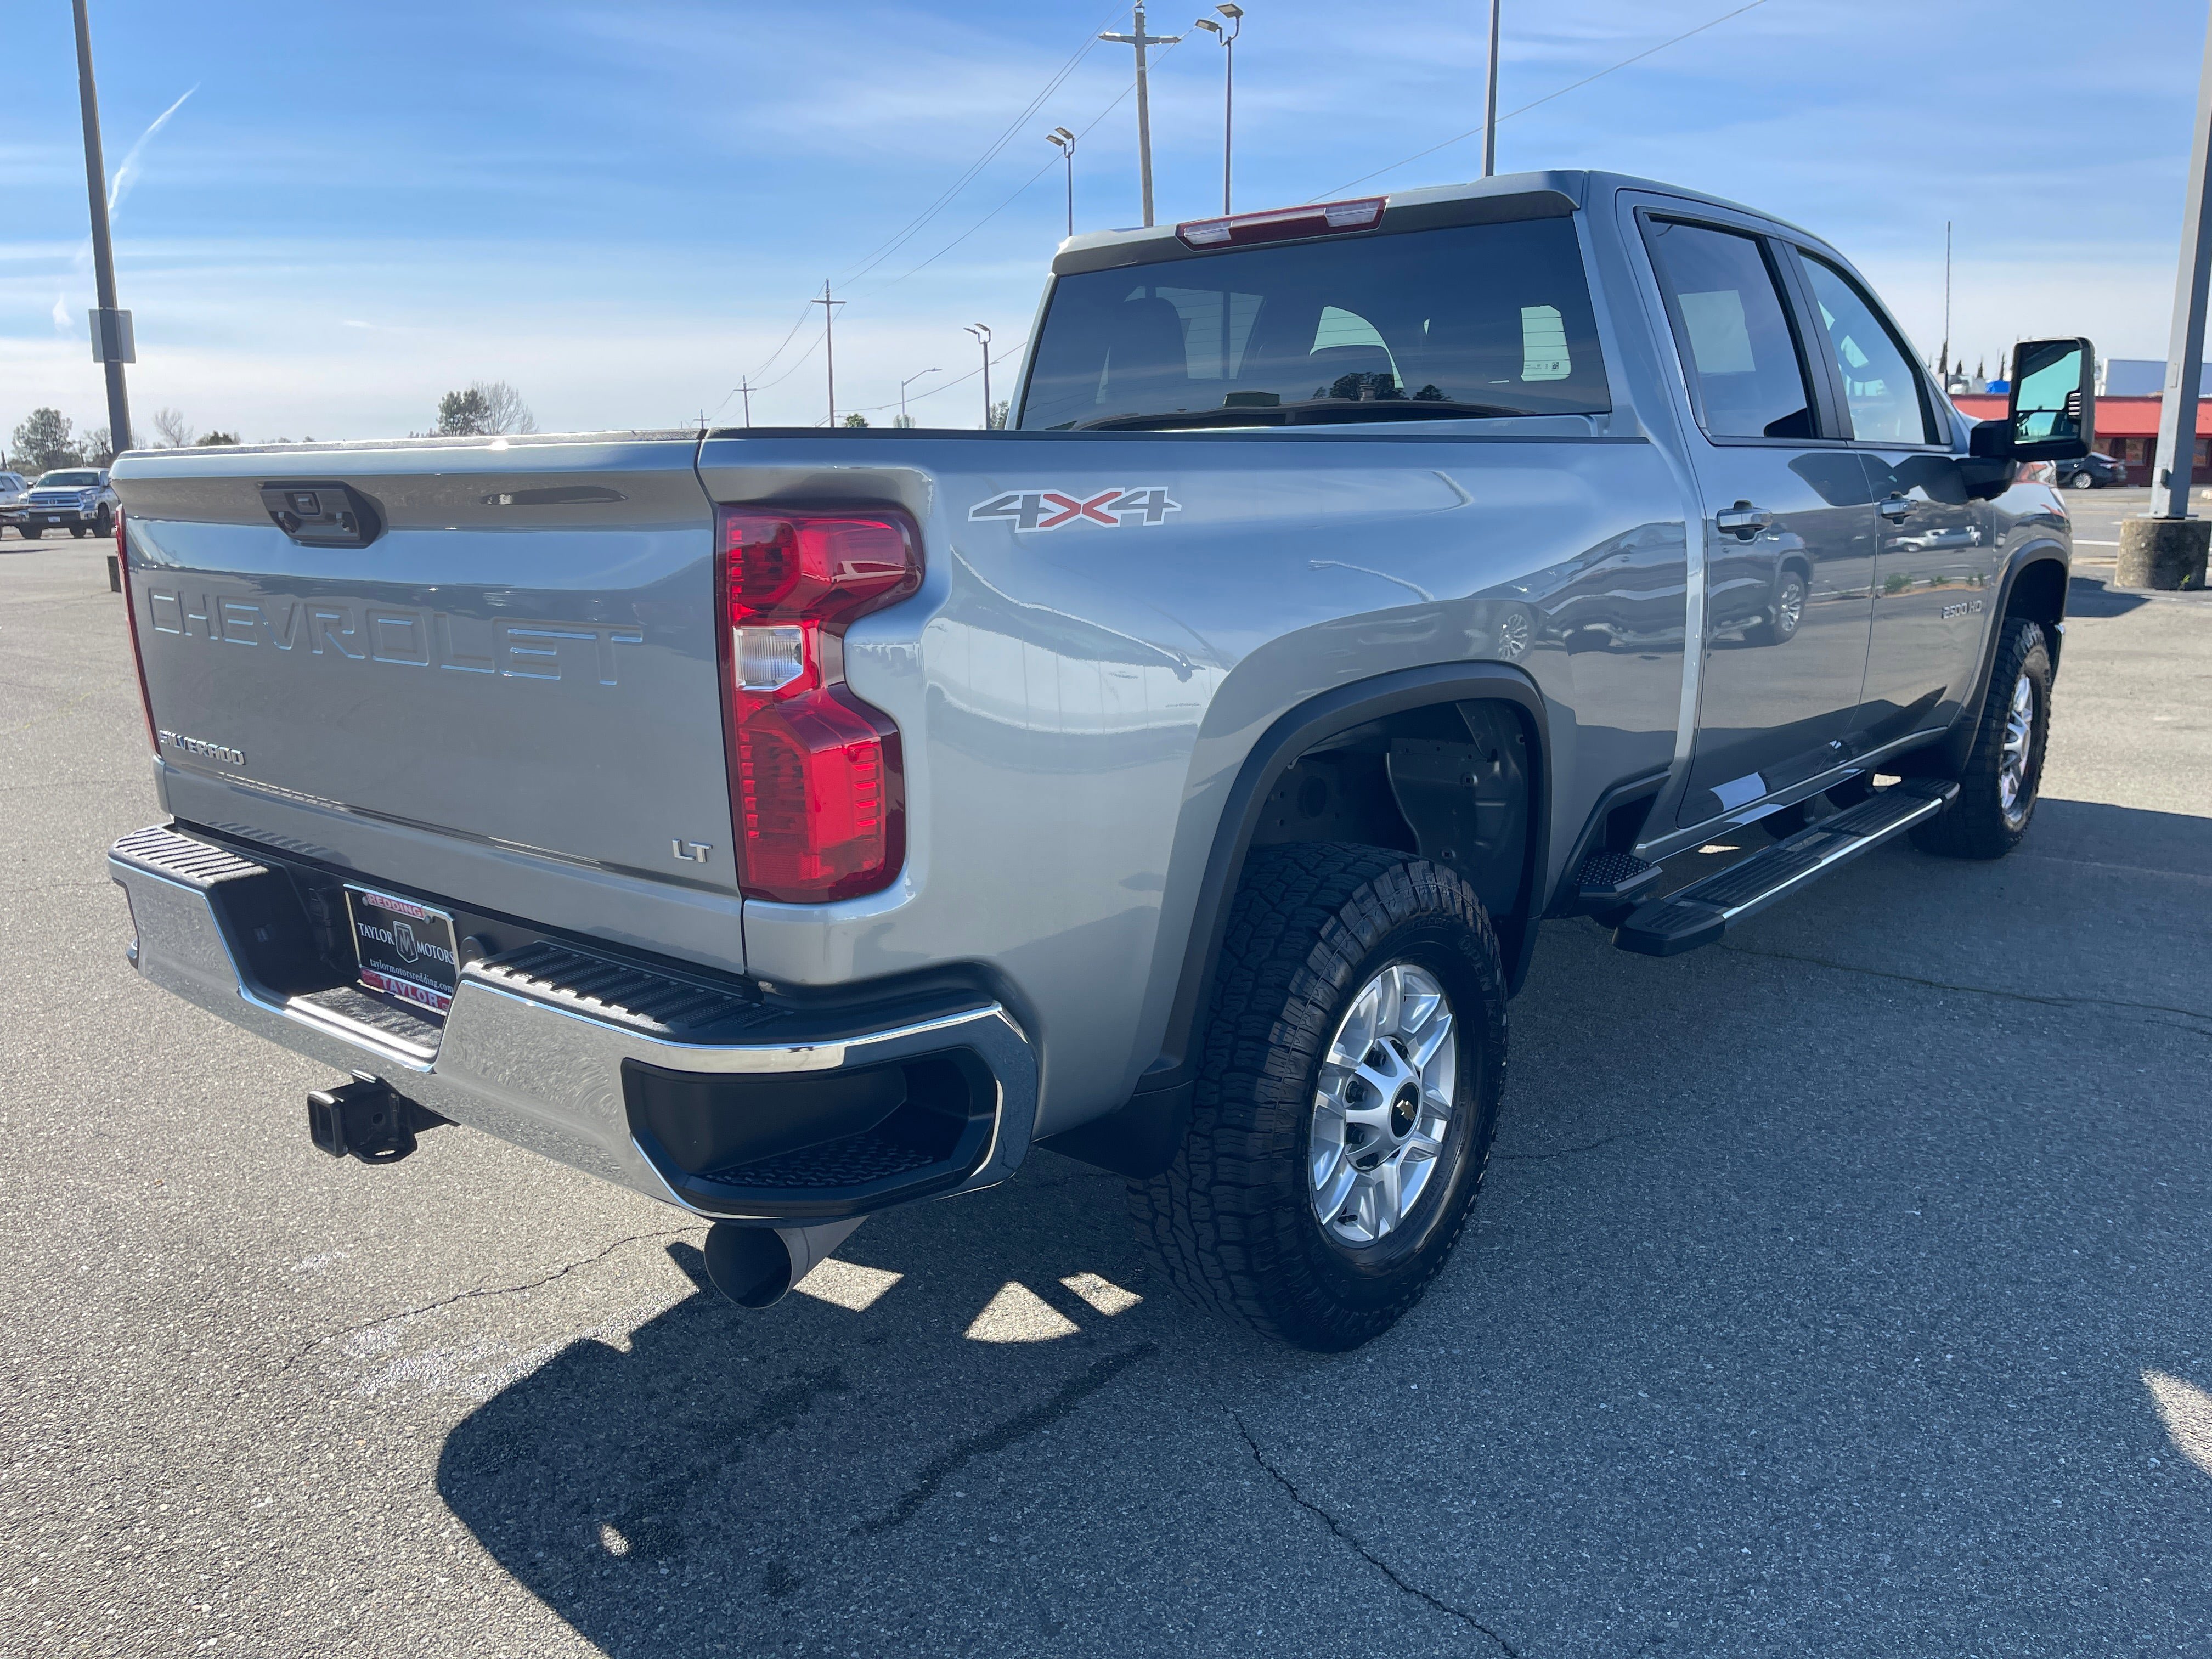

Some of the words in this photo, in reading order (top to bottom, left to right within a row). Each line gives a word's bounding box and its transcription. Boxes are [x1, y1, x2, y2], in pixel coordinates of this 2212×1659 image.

[149, 587, 643, 686] CHEVROLET
[159, 730, 246, 765] SILVERADO
[672, 838, 713, 863] LT
[367, 894, 423, 917] REDDING
[357, 922, 395, 945] TAYLOR
[416, 940, 455, 965] MOTORS
[370, 958, 453, 993] taylormotorsredding.com
[1458, 935, 1493, 992] OPEN
[380, 975, 439, 1008] TAYLOR
